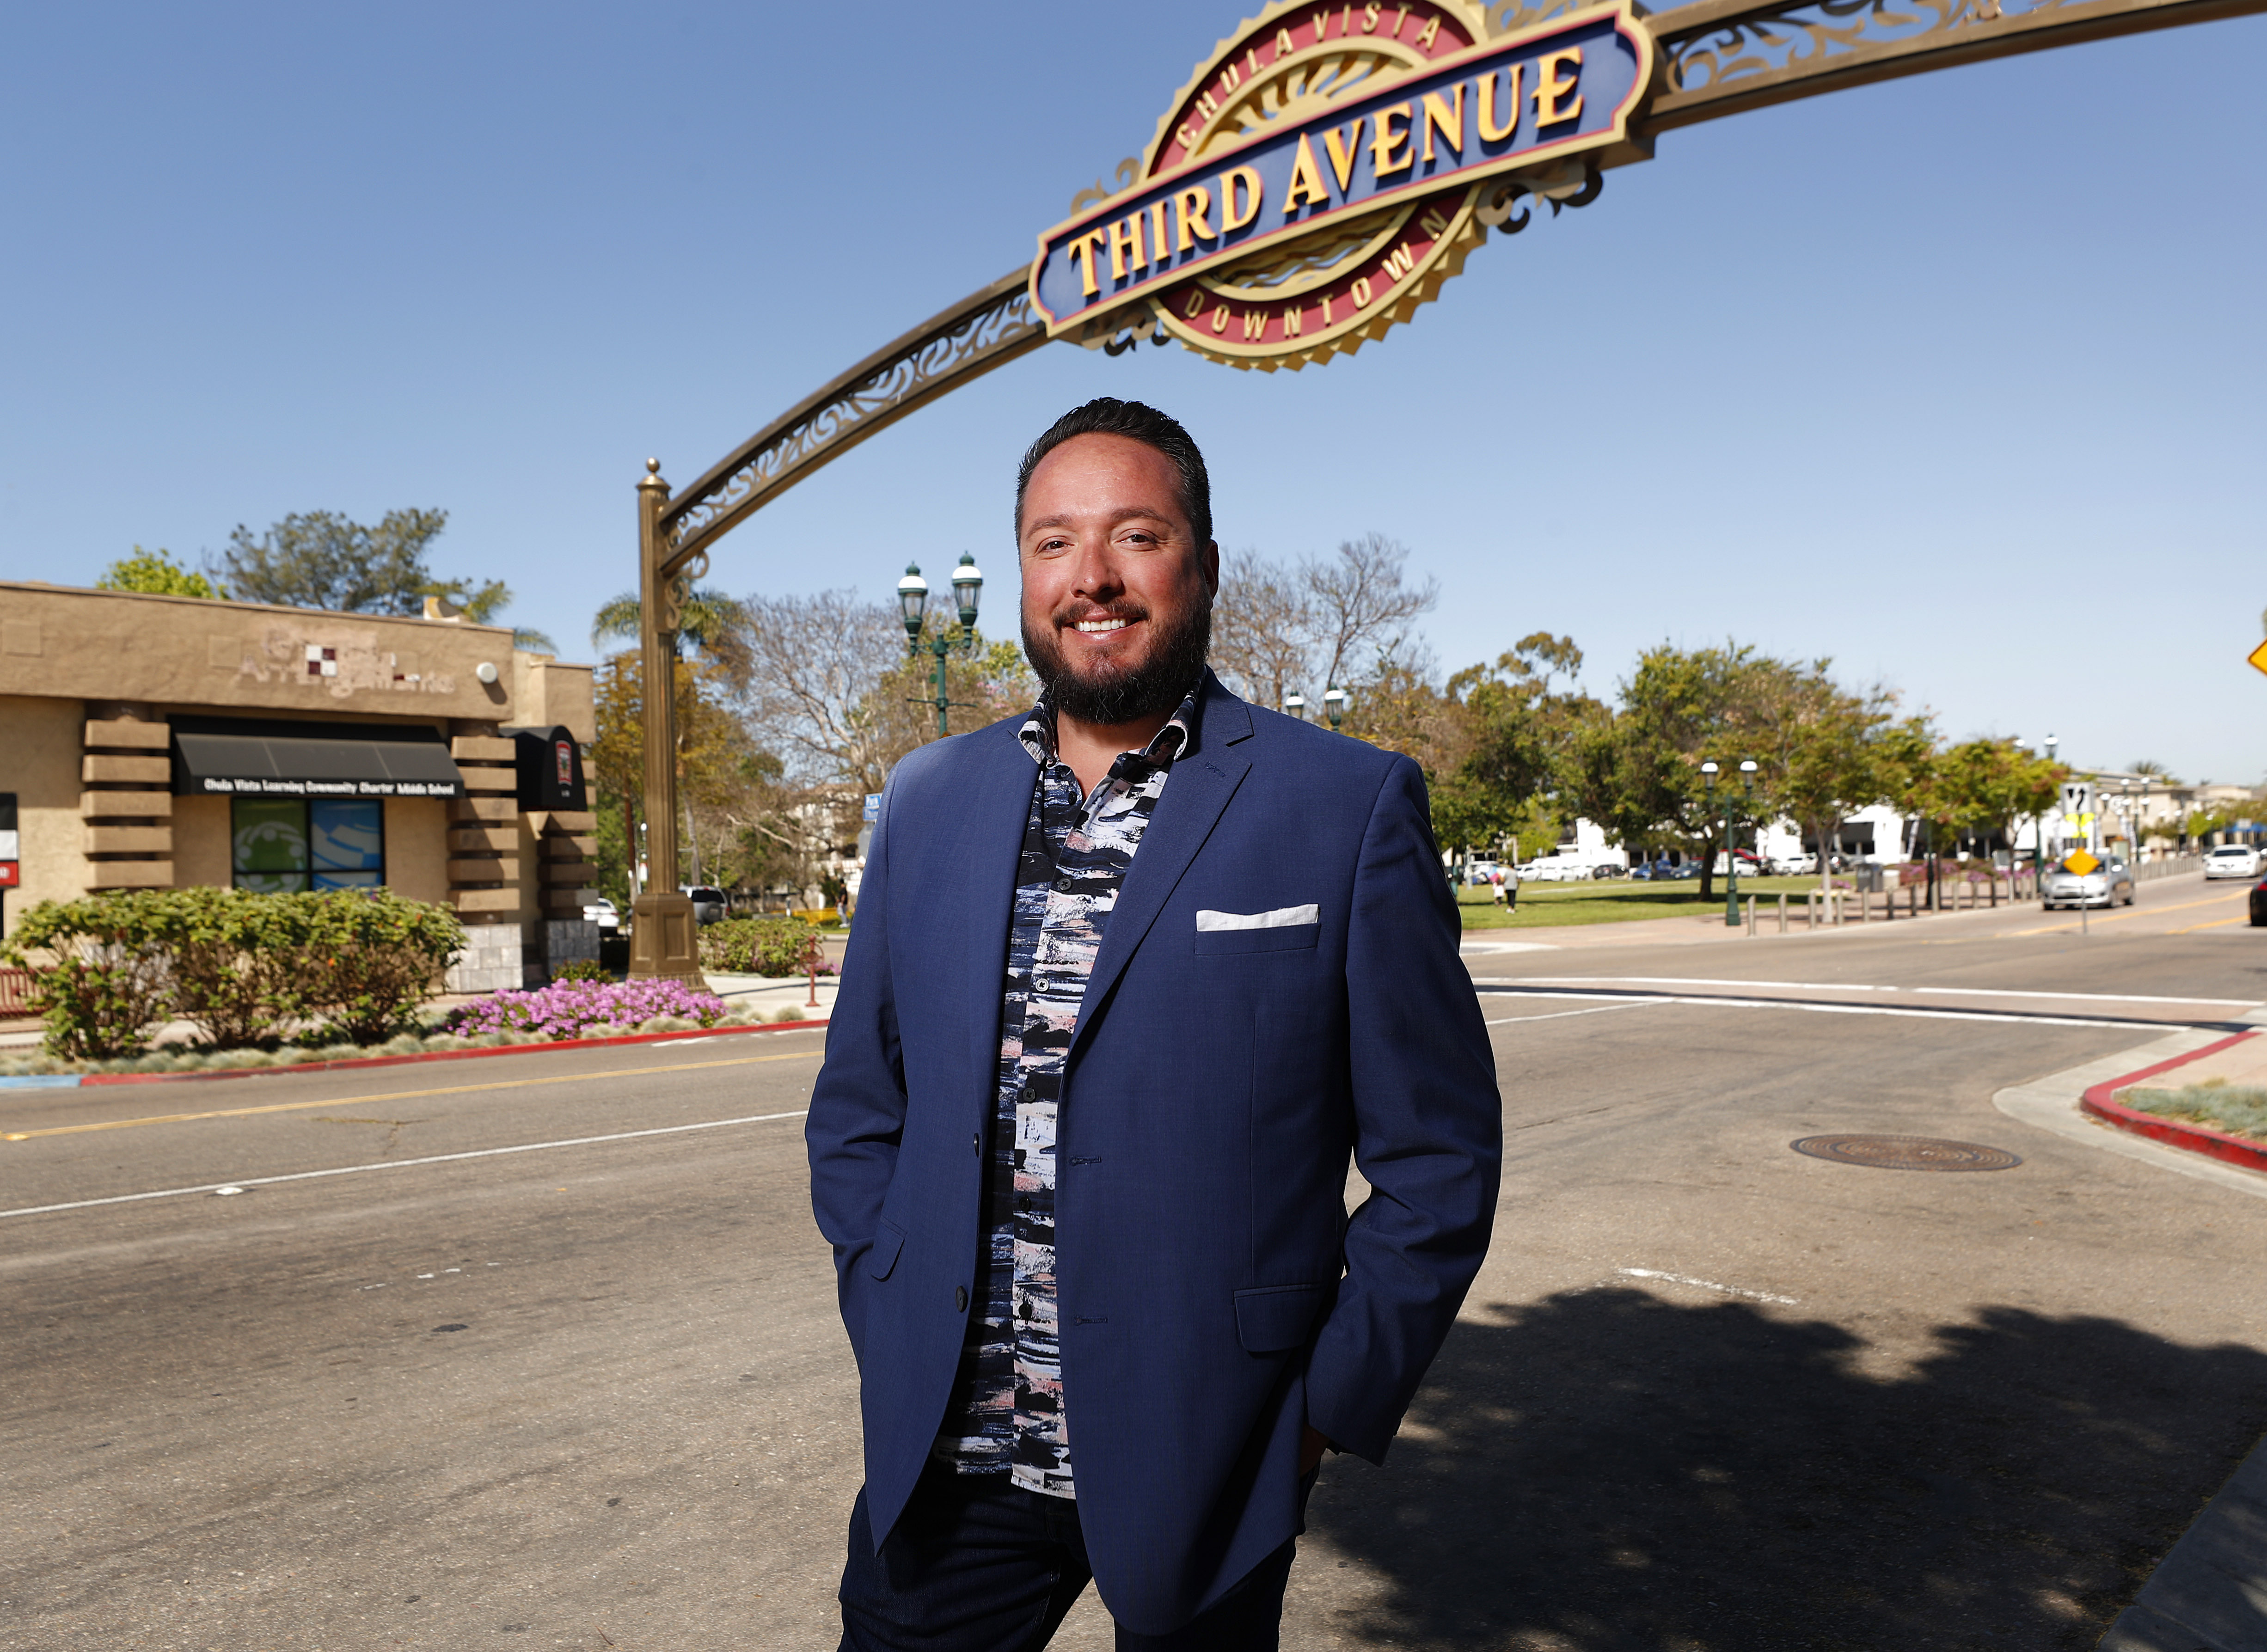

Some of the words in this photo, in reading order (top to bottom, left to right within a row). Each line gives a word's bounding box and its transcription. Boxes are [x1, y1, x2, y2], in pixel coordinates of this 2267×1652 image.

[1176, 27, 1293, 149] CHULA
[1312, 1, 1442, 50] VISTA
[1068, 165, 1263, 297] THIRD
[1281, 45, 1585, 213] AVENUE
[1184, 208, 1448, 341] DOWNTOWN
[204, 777, 234, 791] Chula
[234, 778, 262, 792] Vista
[262, 779, 305, 794] Learning
[305, 780, 358, 795] Community
[359, 781, 395, 794] Charter
[396, 783, 427, 795] Middle
[427, 783, 455, 795] School
